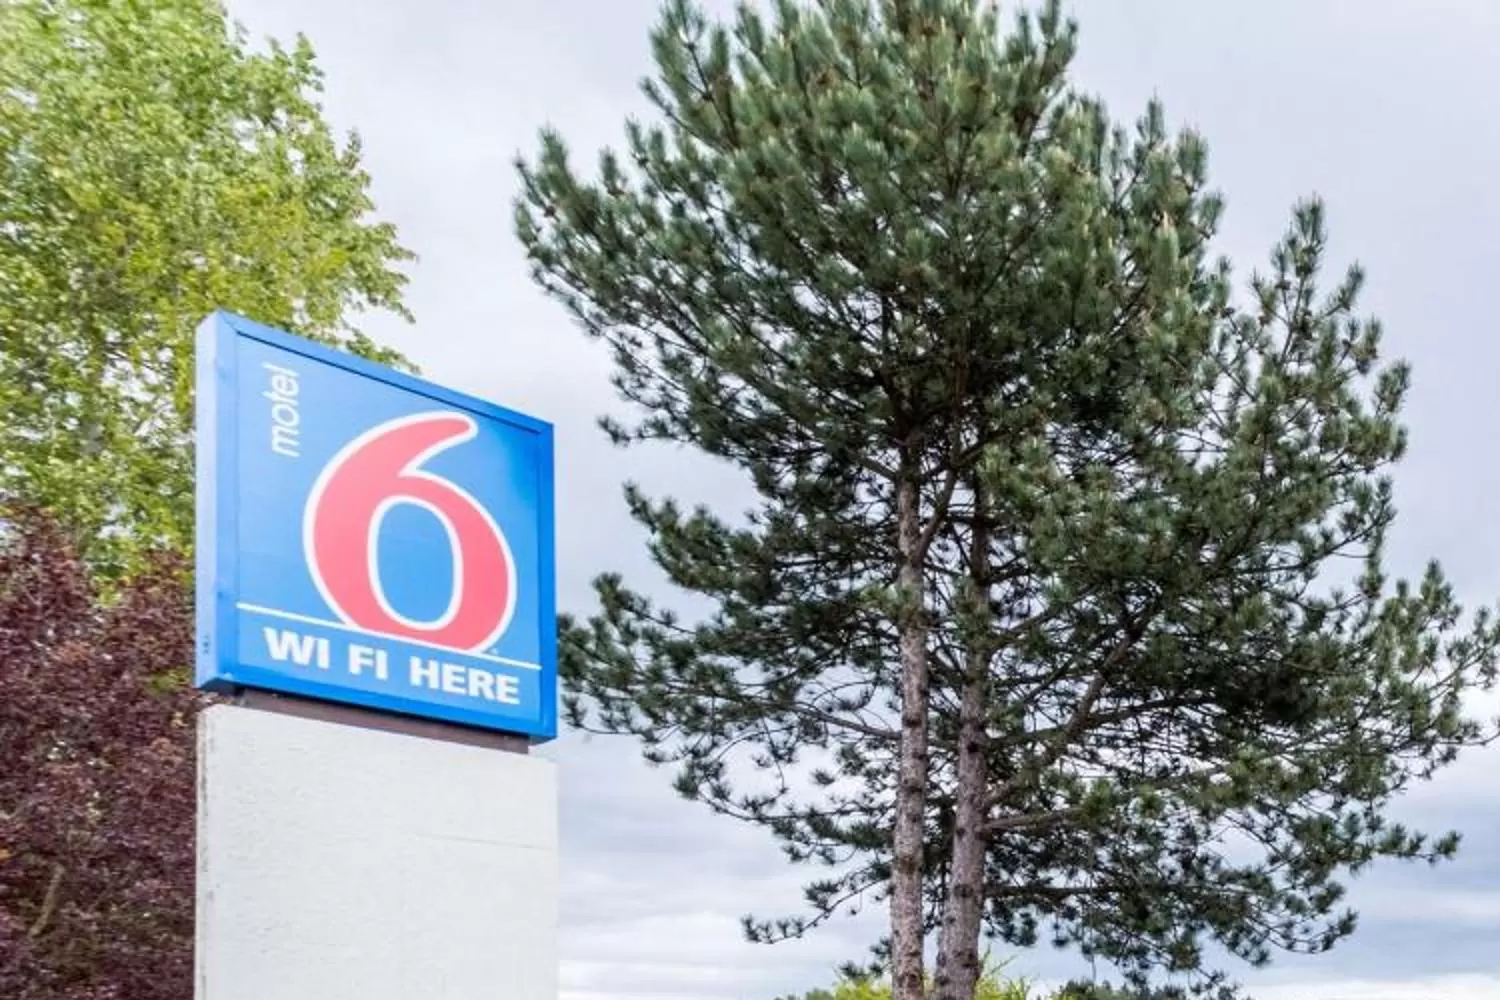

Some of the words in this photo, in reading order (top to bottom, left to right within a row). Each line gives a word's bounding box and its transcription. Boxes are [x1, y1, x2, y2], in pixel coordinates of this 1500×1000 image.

[262, 364, 299, 457] motel
[303, 411, 518, 657] 6
[263, 626, 330, 670] WI
[348, 643, 388, 681] FI
[410, 656, 521, 706] HERE
